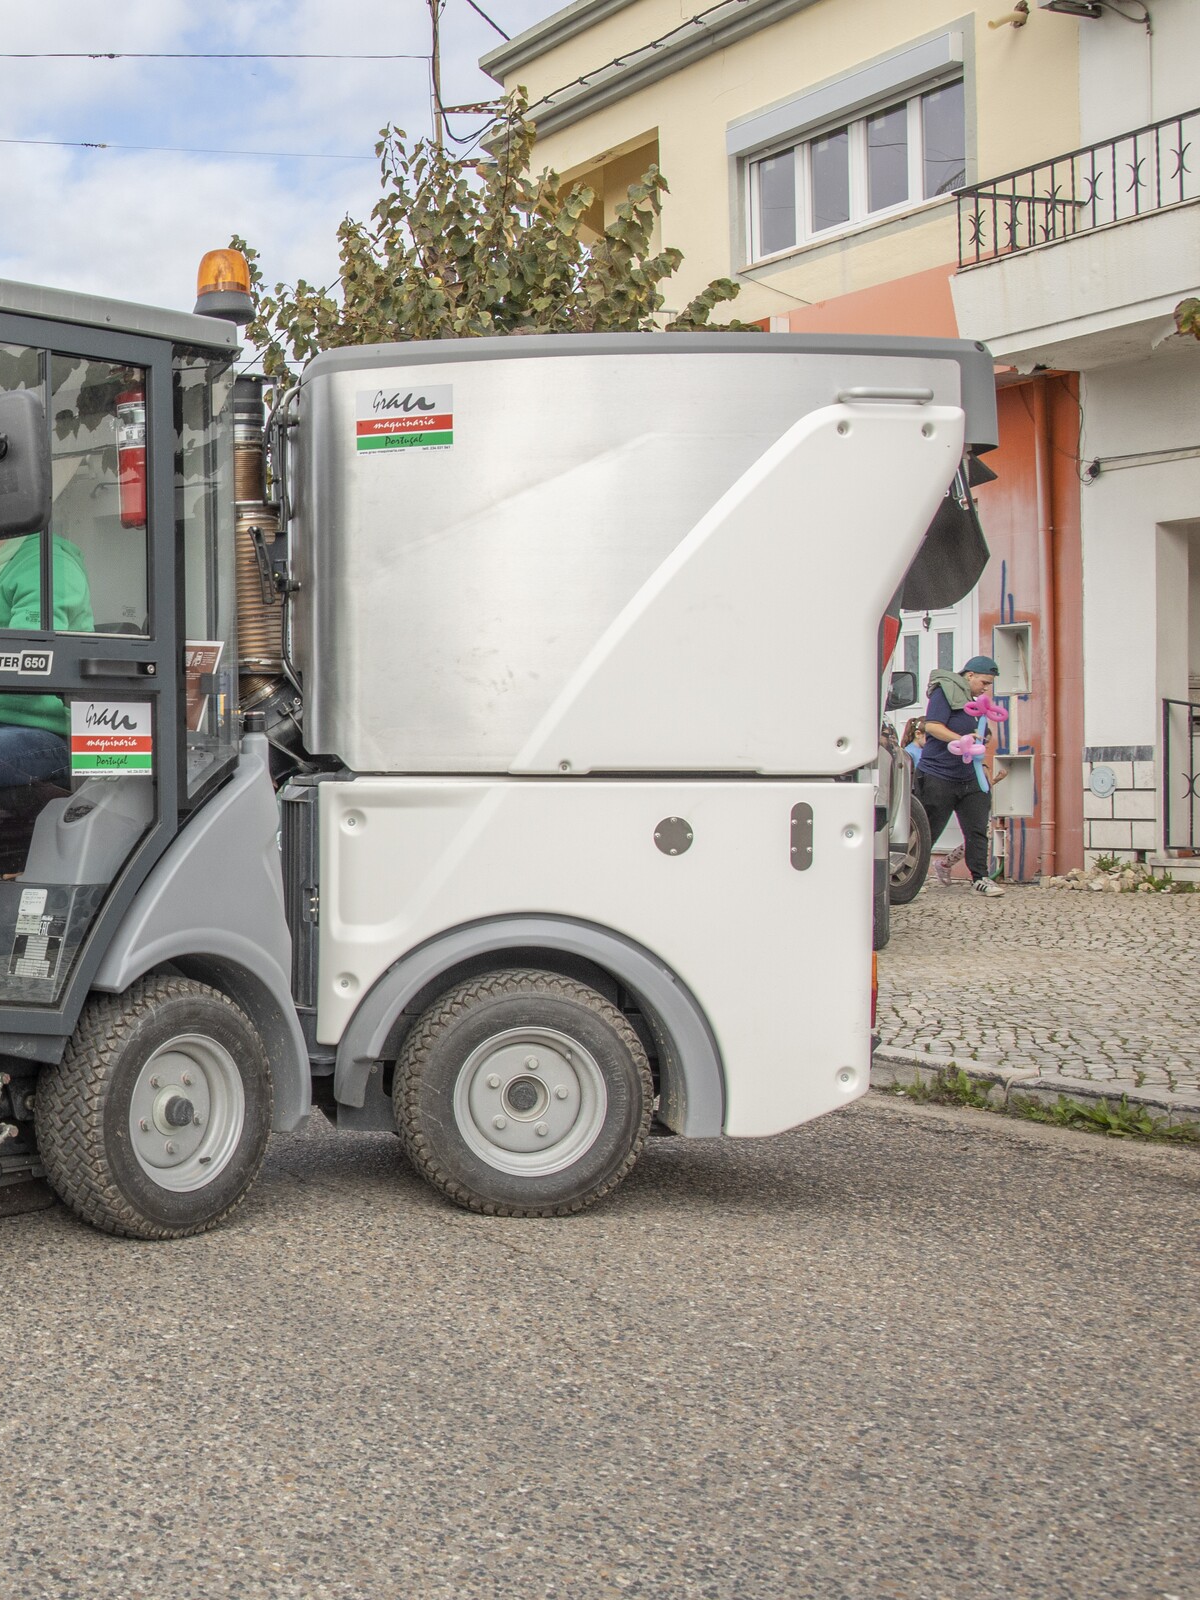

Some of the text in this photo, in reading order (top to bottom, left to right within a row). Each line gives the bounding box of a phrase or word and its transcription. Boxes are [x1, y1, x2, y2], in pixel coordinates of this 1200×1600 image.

[373, 416, 436, 432] maquinaria
[384, 433, 424, 446] Portugal
[24, 657, 46, 669] 650
[86, 736, 138, 751] maquinaria
[96, 754, 129, 768] Portugal
